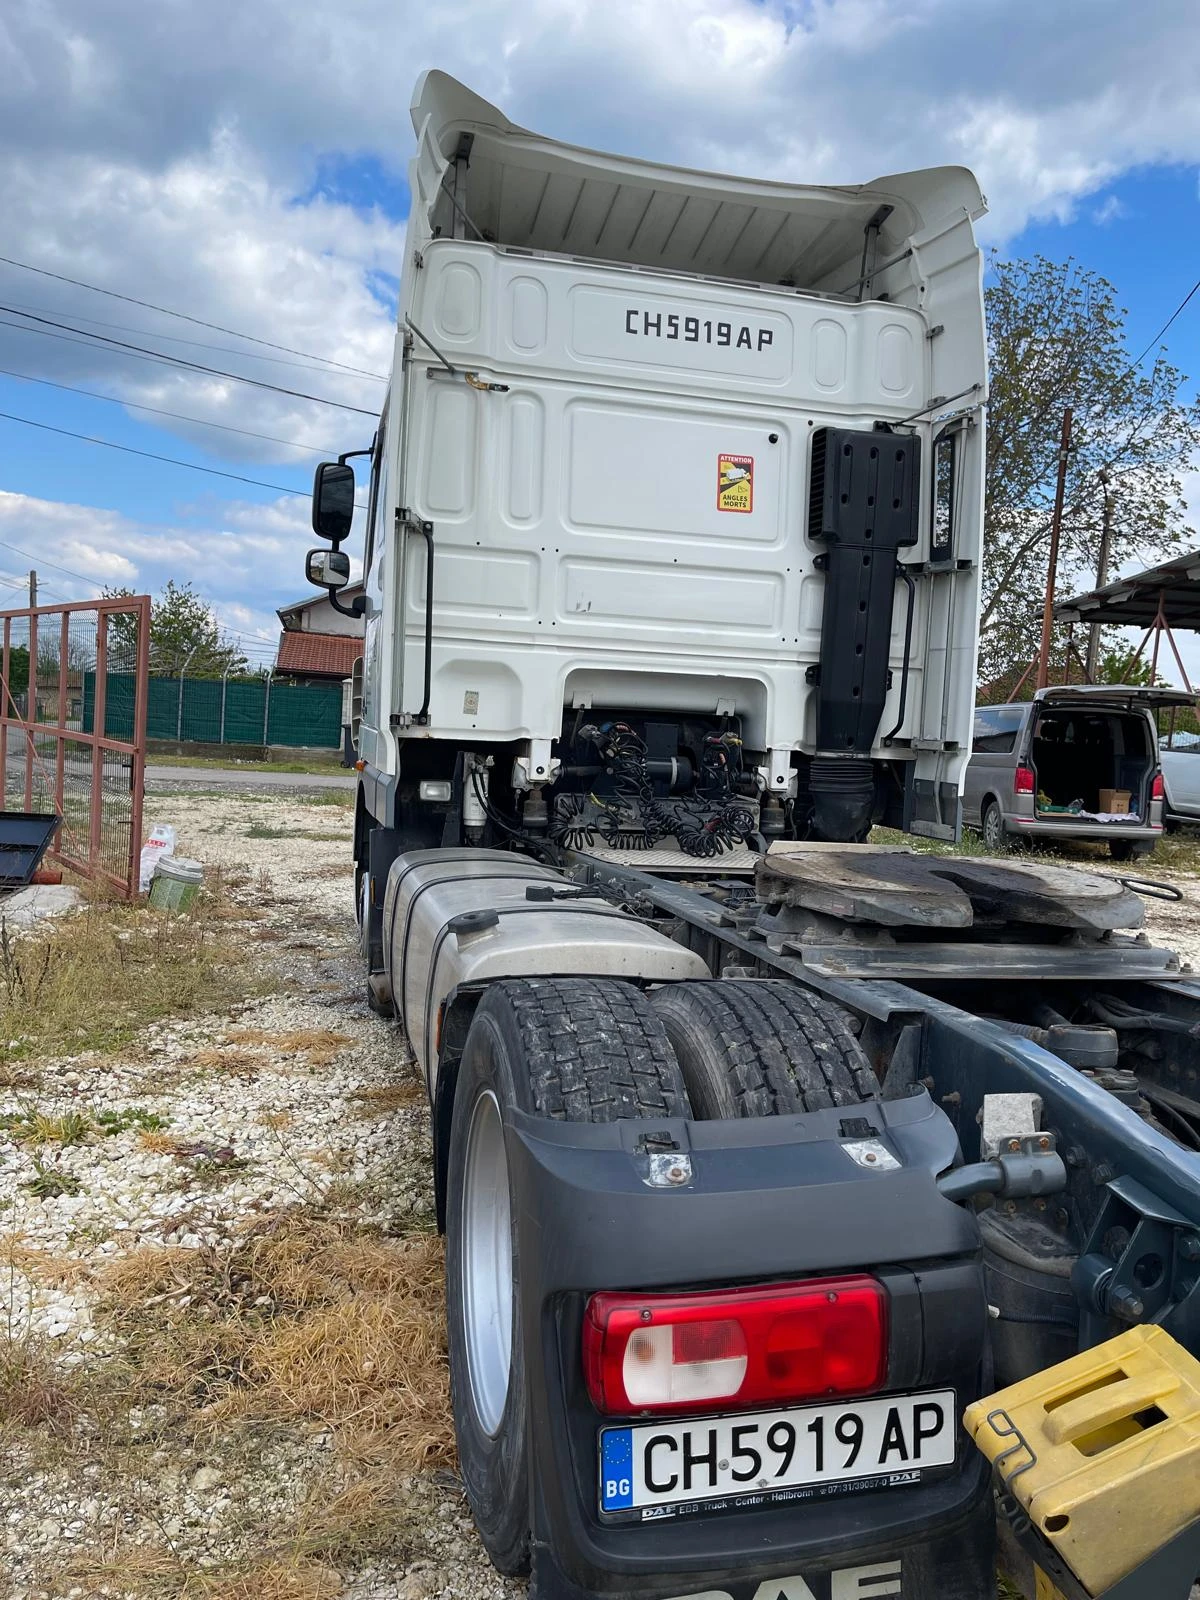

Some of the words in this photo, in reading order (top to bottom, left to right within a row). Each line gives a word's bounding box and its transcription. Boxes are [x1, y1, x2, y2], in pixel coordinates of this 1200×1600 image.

[626, 309, 773, 351] CH5919AP
[721, 455, 752, 463] ATTENTION
[606, 1479, 630, 1498] BG
[642, 1504, 676, 1519] DAF
[704, 1500, 728, 1511] Truck
[735, 1495, 765, 1507] Center
[771, 1489, 814, 1501] Heilbronn
[889, 1470, 921, 1484] DAF
